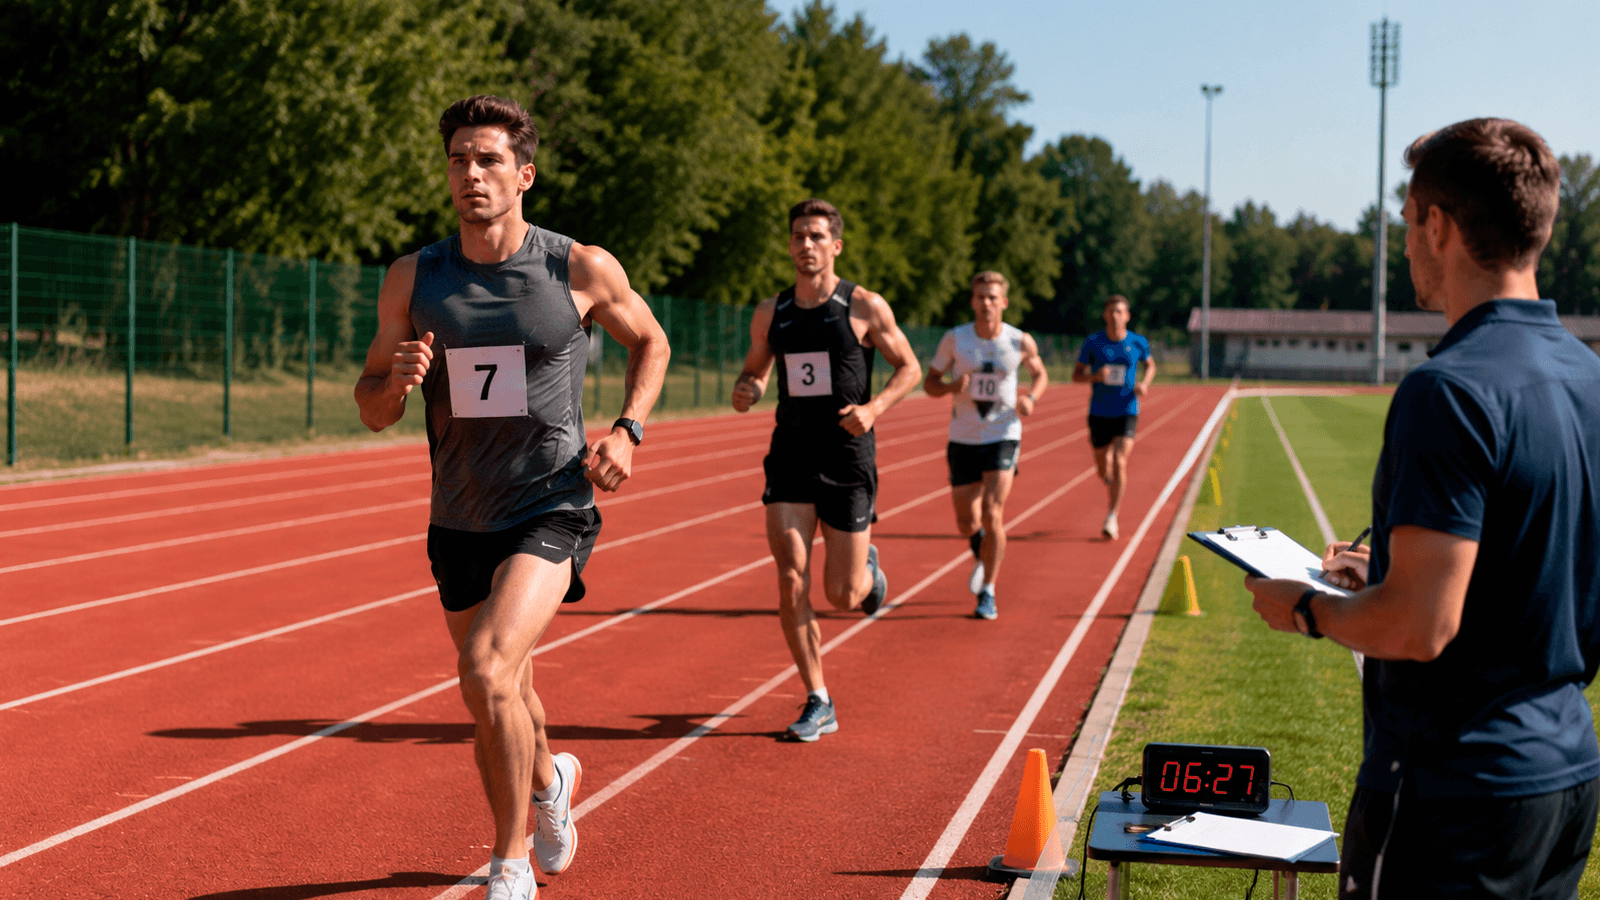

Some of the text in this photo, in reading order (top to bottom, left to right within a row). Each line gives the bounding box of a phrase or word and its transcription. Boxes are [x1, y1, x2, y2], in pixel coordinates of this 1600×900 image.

[474, 363, 498, 401] 7
[801, 365, 816, 387] 3
[978, 379, 995, 396] 10
[1160, 761, 1255, 795] 06:27
